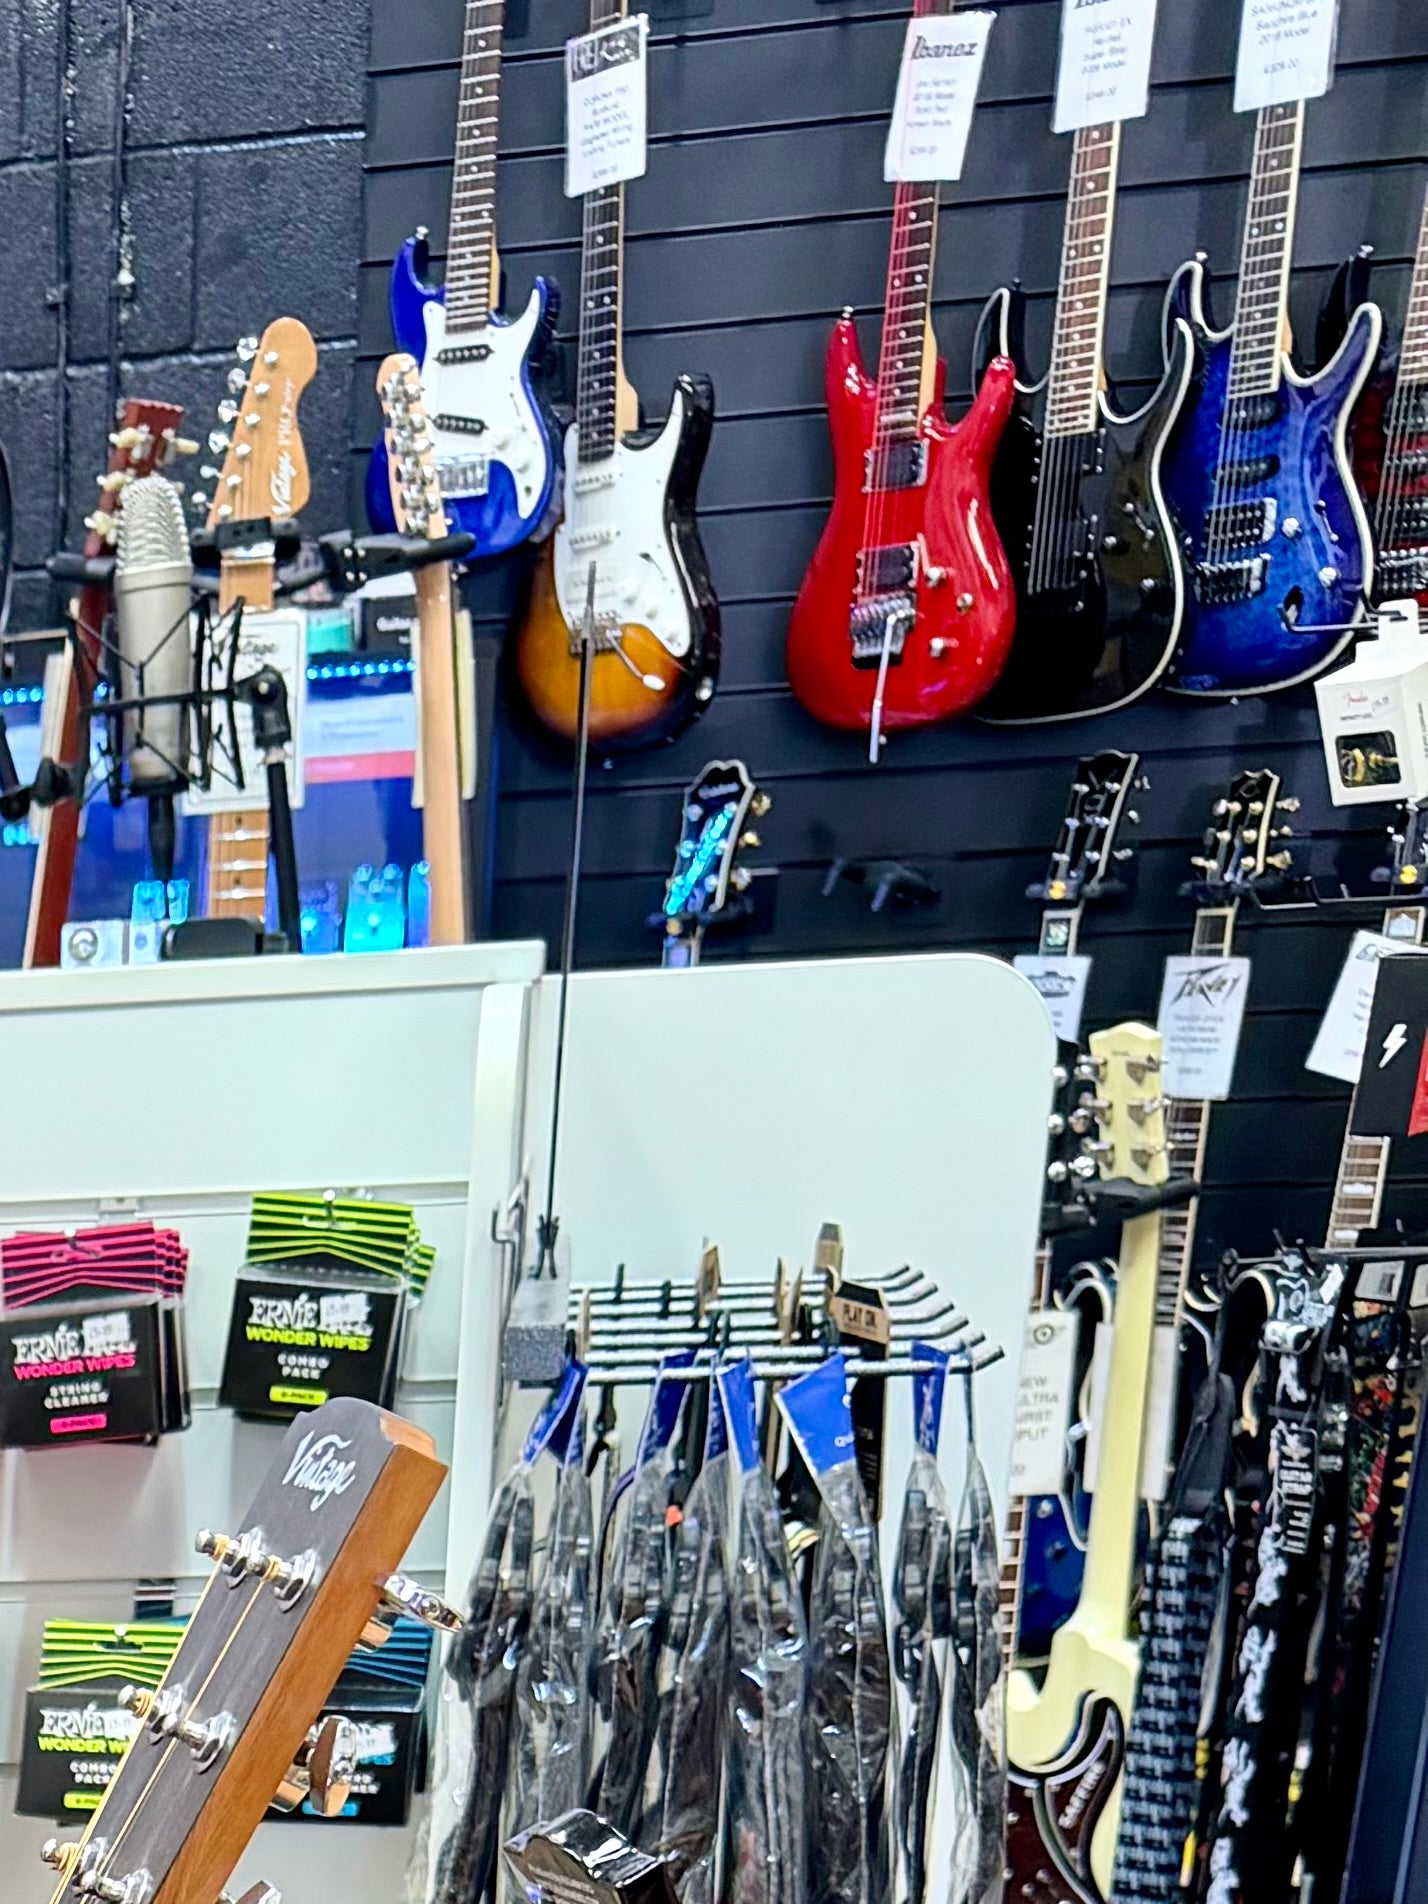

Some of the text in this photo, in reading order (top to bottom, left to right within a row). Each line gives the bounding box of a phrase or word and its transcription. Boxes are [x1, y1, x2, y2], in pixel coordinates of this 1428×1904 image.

[911, 36, 978, 61] Ibanez
[246, 1325, 372, 1352] WONDER WIPES
[13, 1353, 137, 1381] WONDER WIPES
[277, 1353, 329, 1369] COMBO
[281, 1366, 321, 1381] PACK
[282, 1431, 356, 1512] Vintage
[38, 1736, 105, 1755] WONDER
